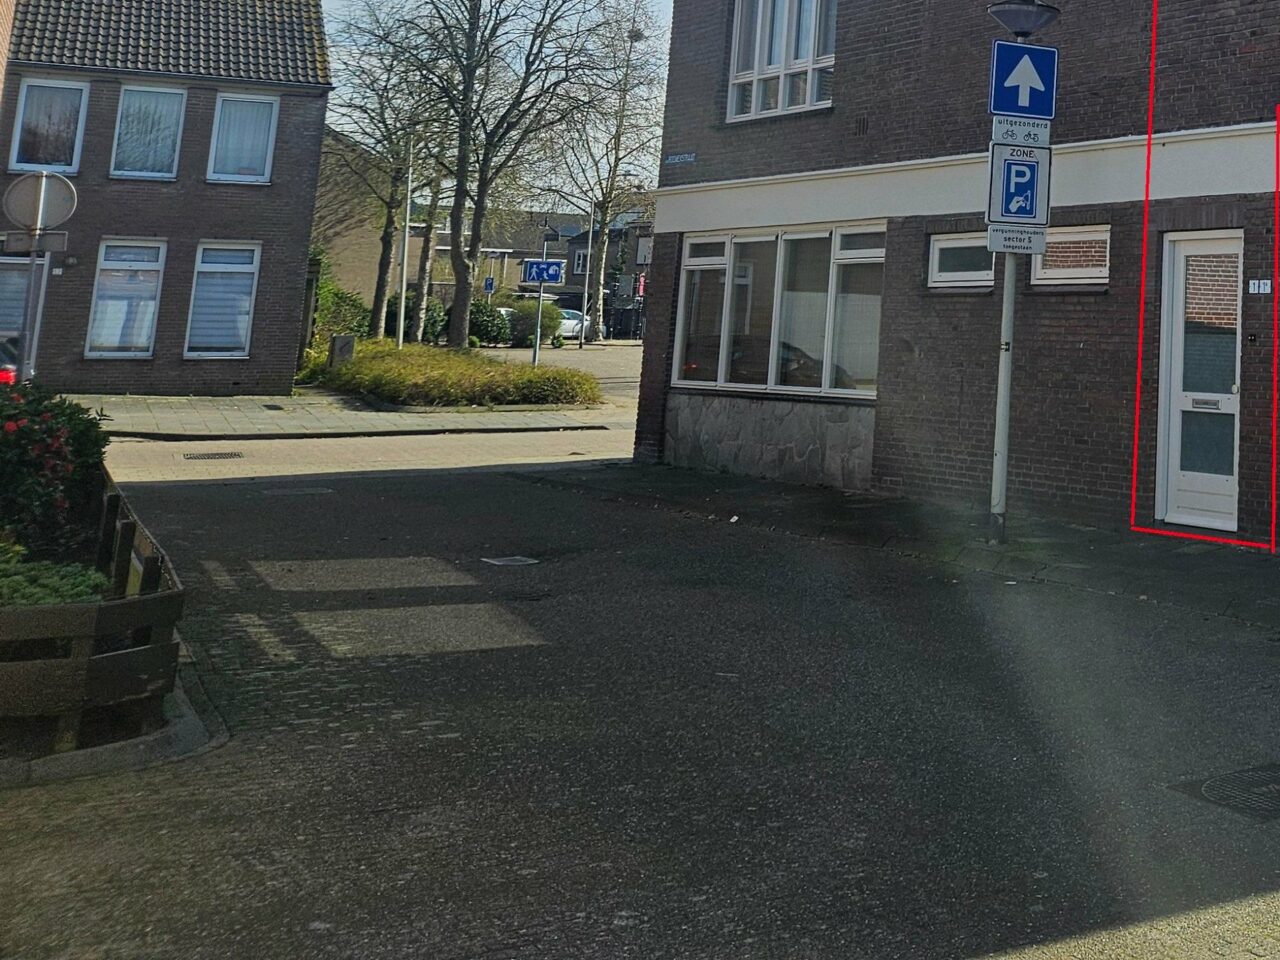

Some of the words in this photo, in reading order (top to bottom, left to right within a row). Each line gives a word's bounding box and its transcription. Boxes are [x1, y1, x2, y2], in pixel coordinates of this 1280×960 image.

[998, 118, 1048, 129] uitgezonderd
[1009, 148, 1035, 159] ZONE
[1009, 164, 1031, 193] P
